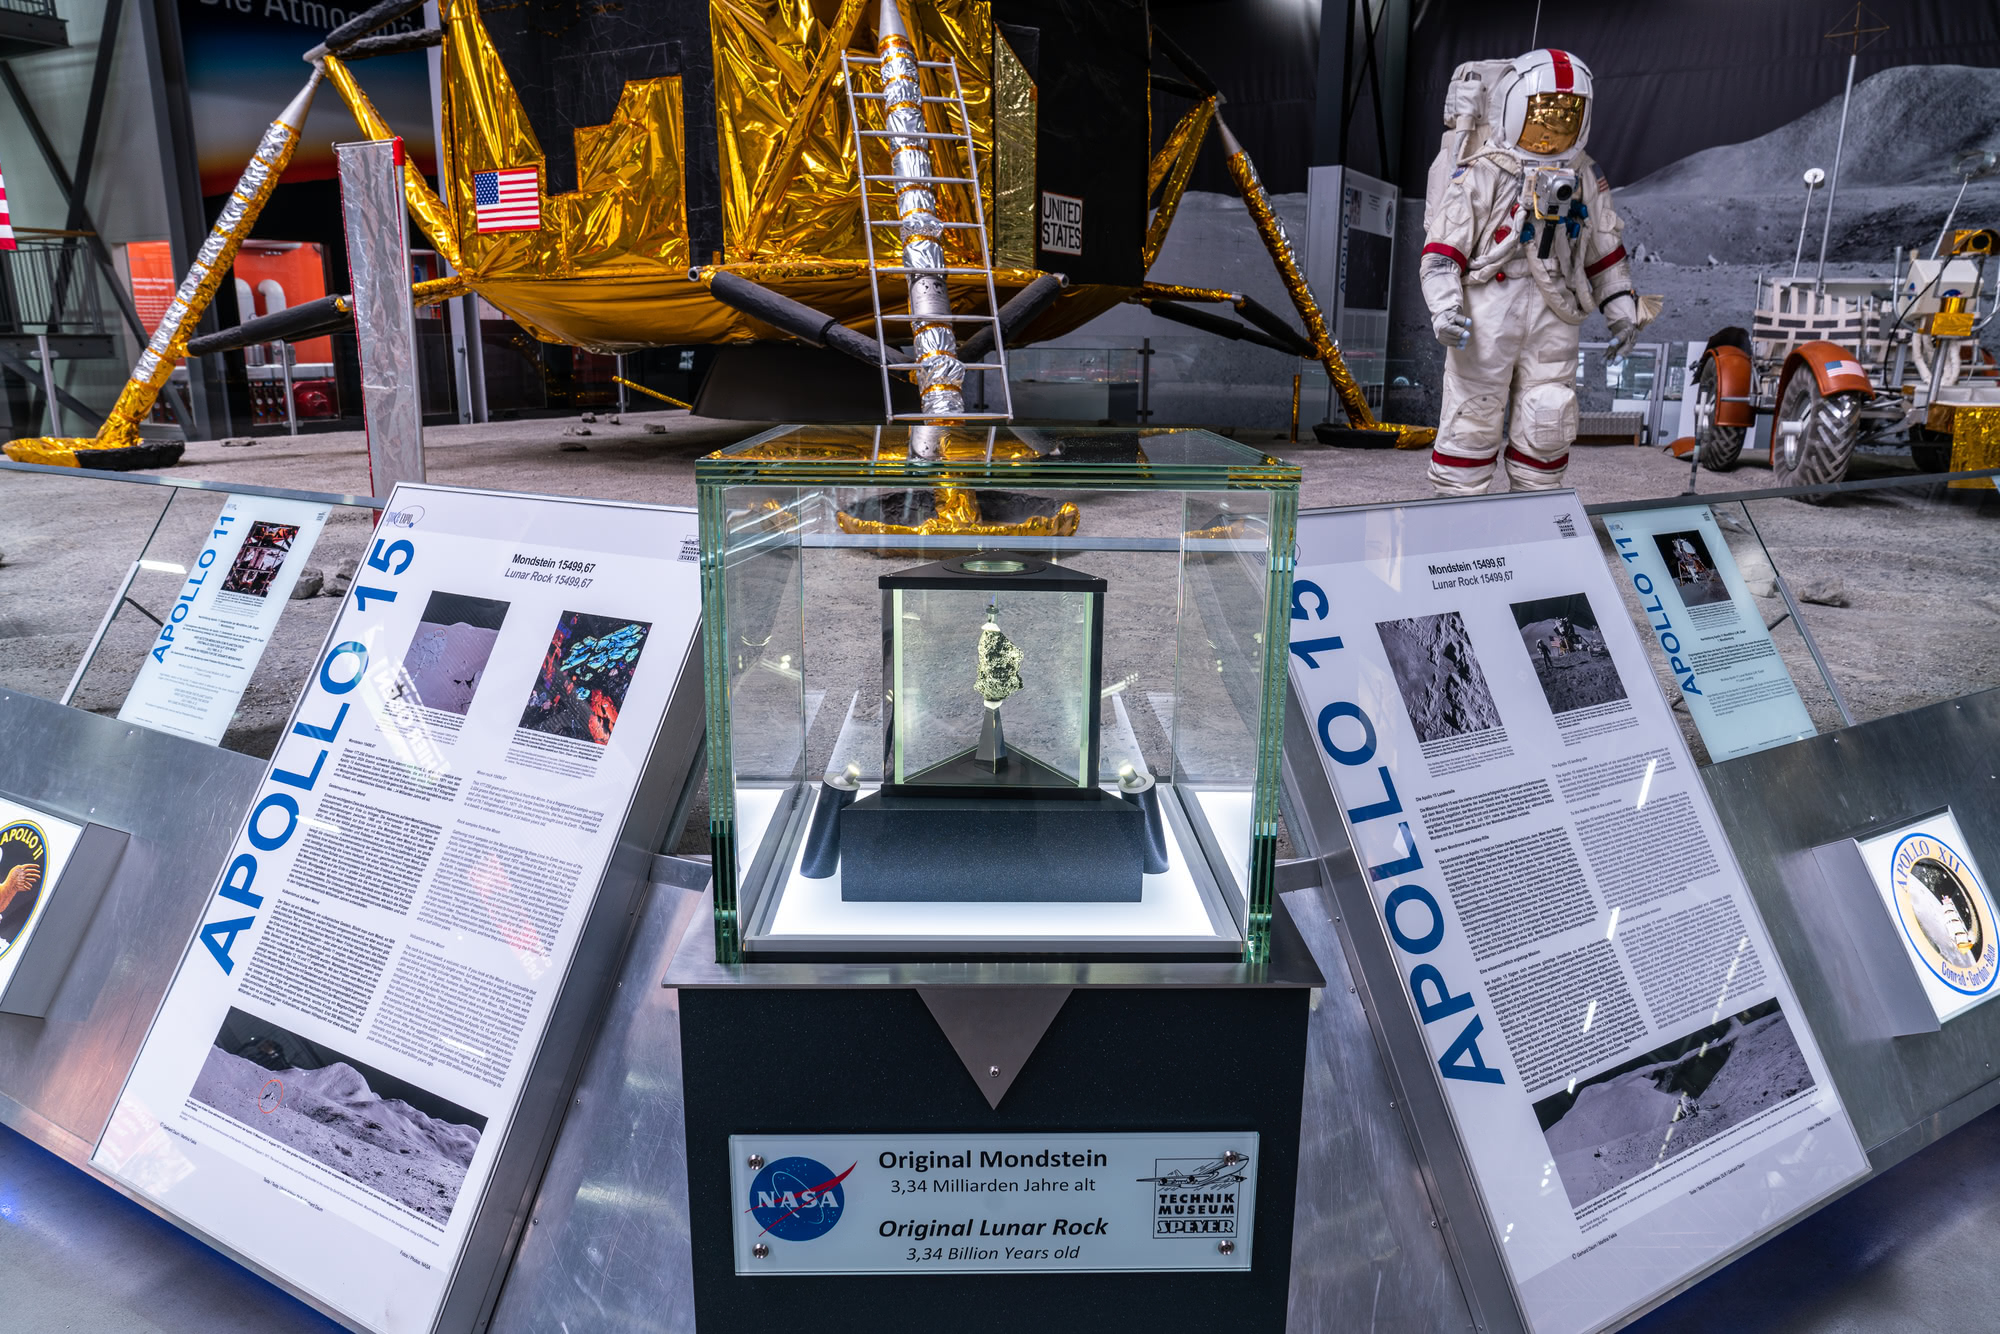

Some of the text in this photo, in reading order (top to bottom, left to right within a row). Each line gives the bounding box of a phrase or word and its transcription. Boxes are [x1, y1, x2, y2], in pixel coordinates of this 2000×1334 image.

[1044, 196, 1080, 225] UNITED
[1043, 222, 1080, 249] STATES
[512, 554, 596, 573] Mondstein 15499,67
[1428, 557, 1506, 575] Mondstein 15499,67
[505, 568, 593, 588] Lunar Rock 15499,67
[1432, 571, 1513, 590] Lunar Rock 15499,67
[152, 550, 216, 663] APOLLO
[214, 517, 234, 538] 11
[1288, 580, 1344, 669] 15
[1616, 538, 1702, 695] APOLLO 11
[200, 642, 366, 976] APOLLO
[355, 539, 414, 611] 15
[0, 828, 44, 860] APOLLO 11
[1896, 840, 1960, 892] APOLLO XII
[1318, 702, 1504, 1084] APOLLO
[1941, 943, 1996, 987] Conrad Gordon Bean
[879, 1150, 1106, 1172] Original Mondstein
[892, 1178, 1095, 1195] 3,34 Milliarden Jahre alt
[757, 1190, 839, 1208] NASA
[1158, 1204, 1235, 1215] MUSEUM
[1159, 1193, 1235, 1204] TECHNIK
[879, 1218, 1108, 1240] Original Lunar Rock
[1157, 1219, 1234, 1234] SPEYER
[907, 1246, 1080, 1262] 3,34 Billion Years old
